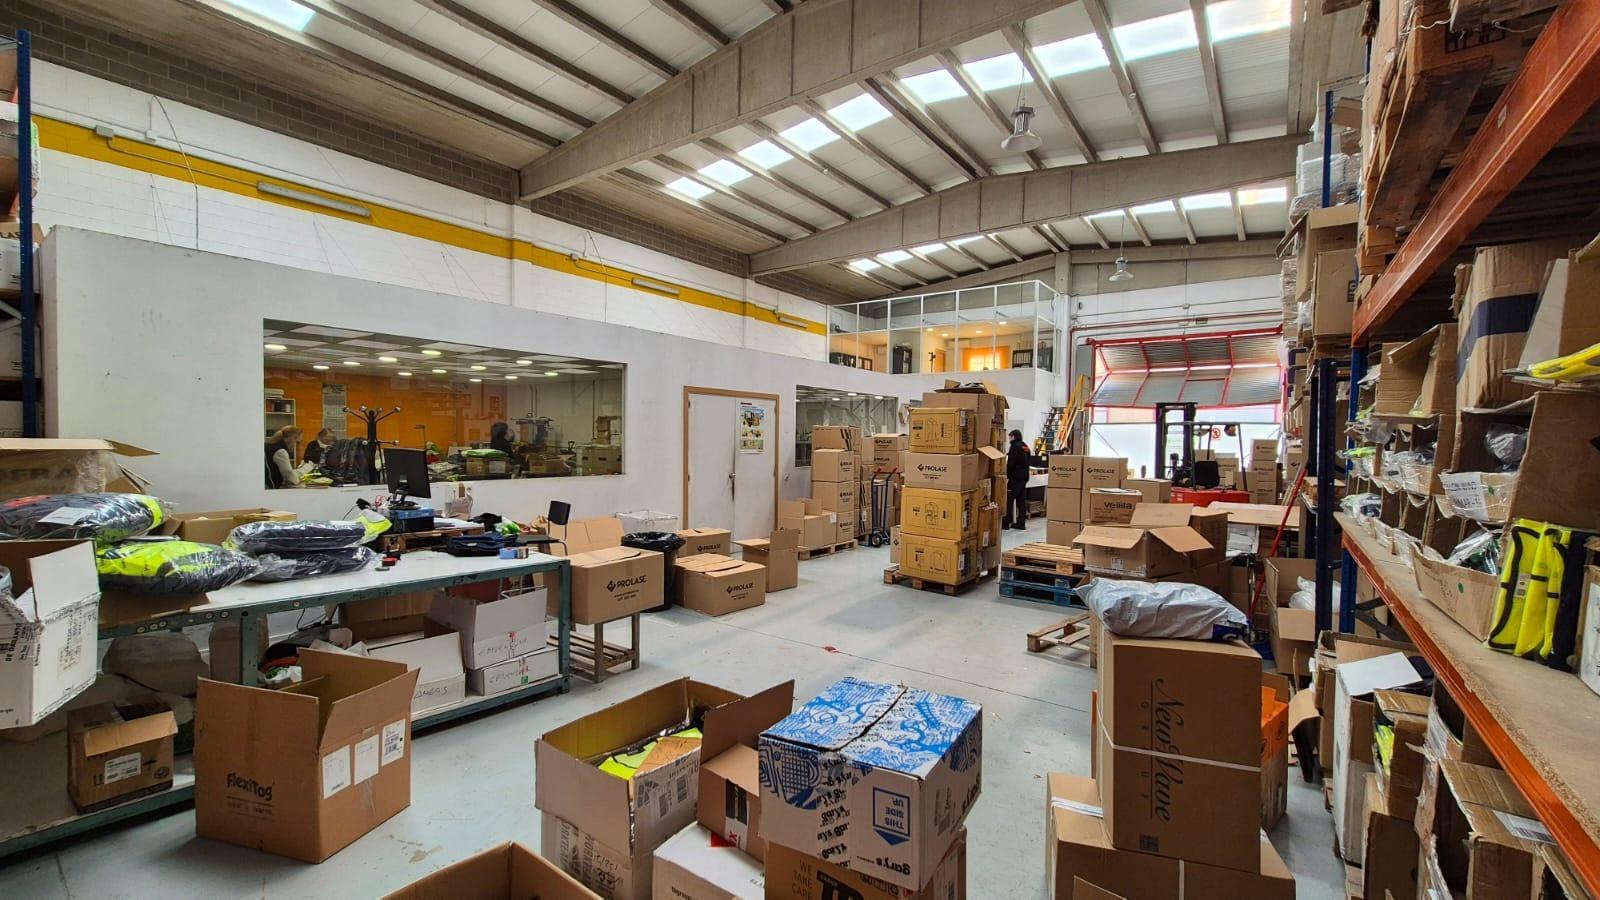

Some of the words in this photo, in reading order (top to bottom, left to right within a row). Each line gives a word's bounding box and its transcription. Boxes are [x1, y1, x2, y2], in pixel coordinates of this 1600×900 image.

[616, 575, 647, 590] PROLASE
[884, 806, 905, 818] SIDE
[883, 817, 905, 830] THIS
[799, 860, 814, 874] WE
[875, 856, 911, 877] gary's
